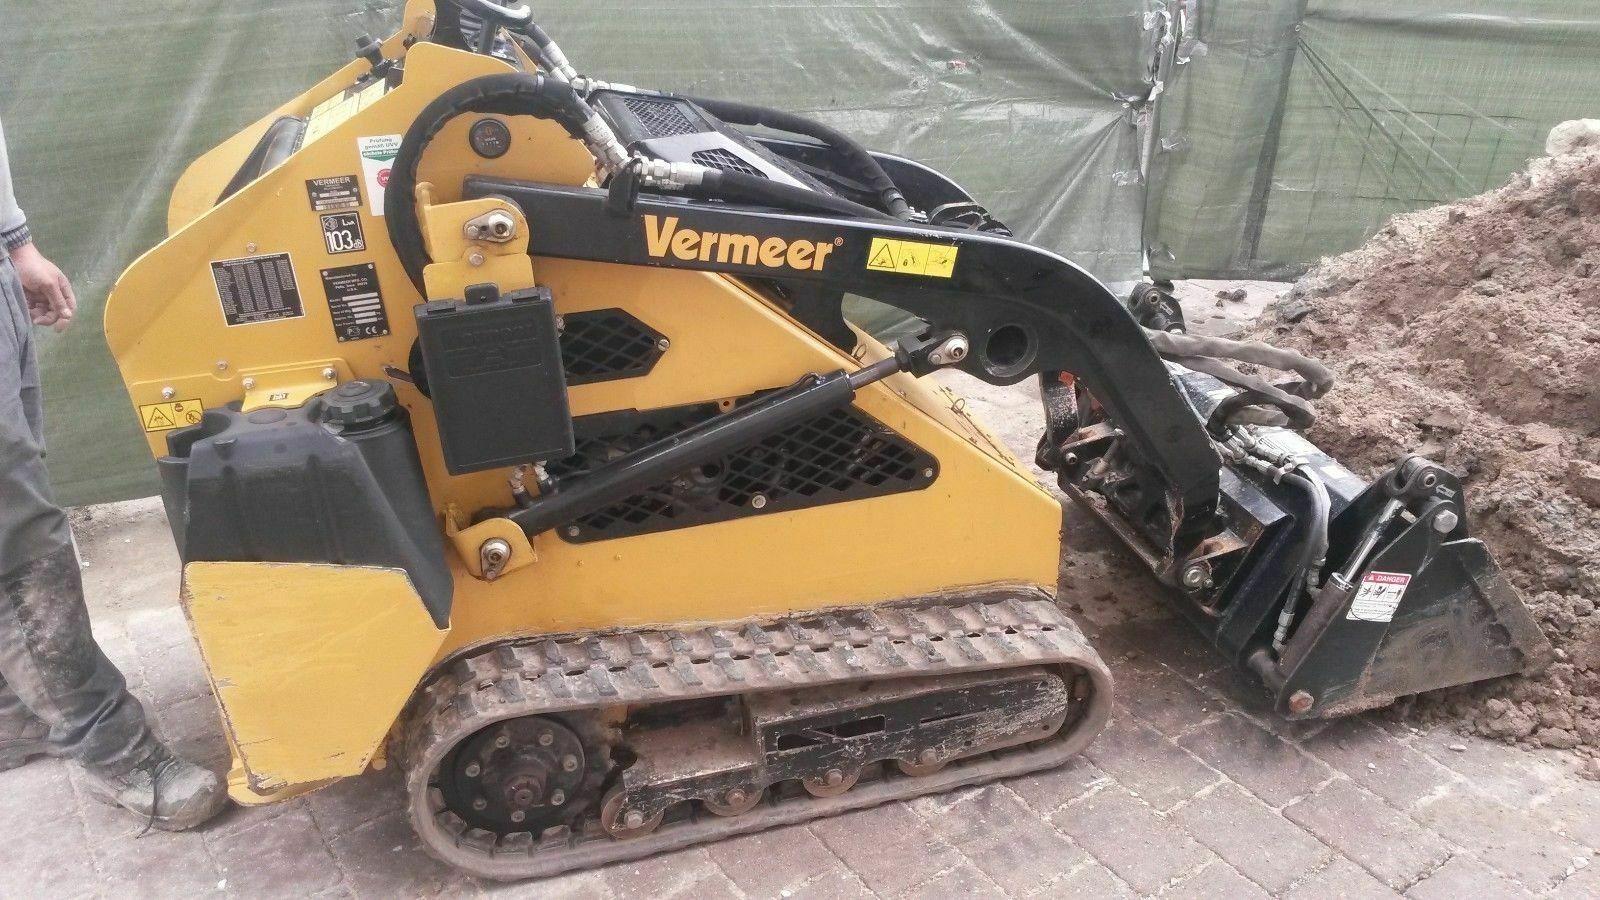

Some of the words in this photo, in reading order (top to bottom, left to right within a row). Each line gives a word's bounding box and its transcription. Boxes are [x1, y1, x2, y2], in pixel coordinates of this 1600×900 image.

[313, 177, 350, 186] VERMEER
[326, 230, 353, 252] 103
[644, 214, 834, 271] Vermeer
[1376, 575, 1406, 583] DANGER
